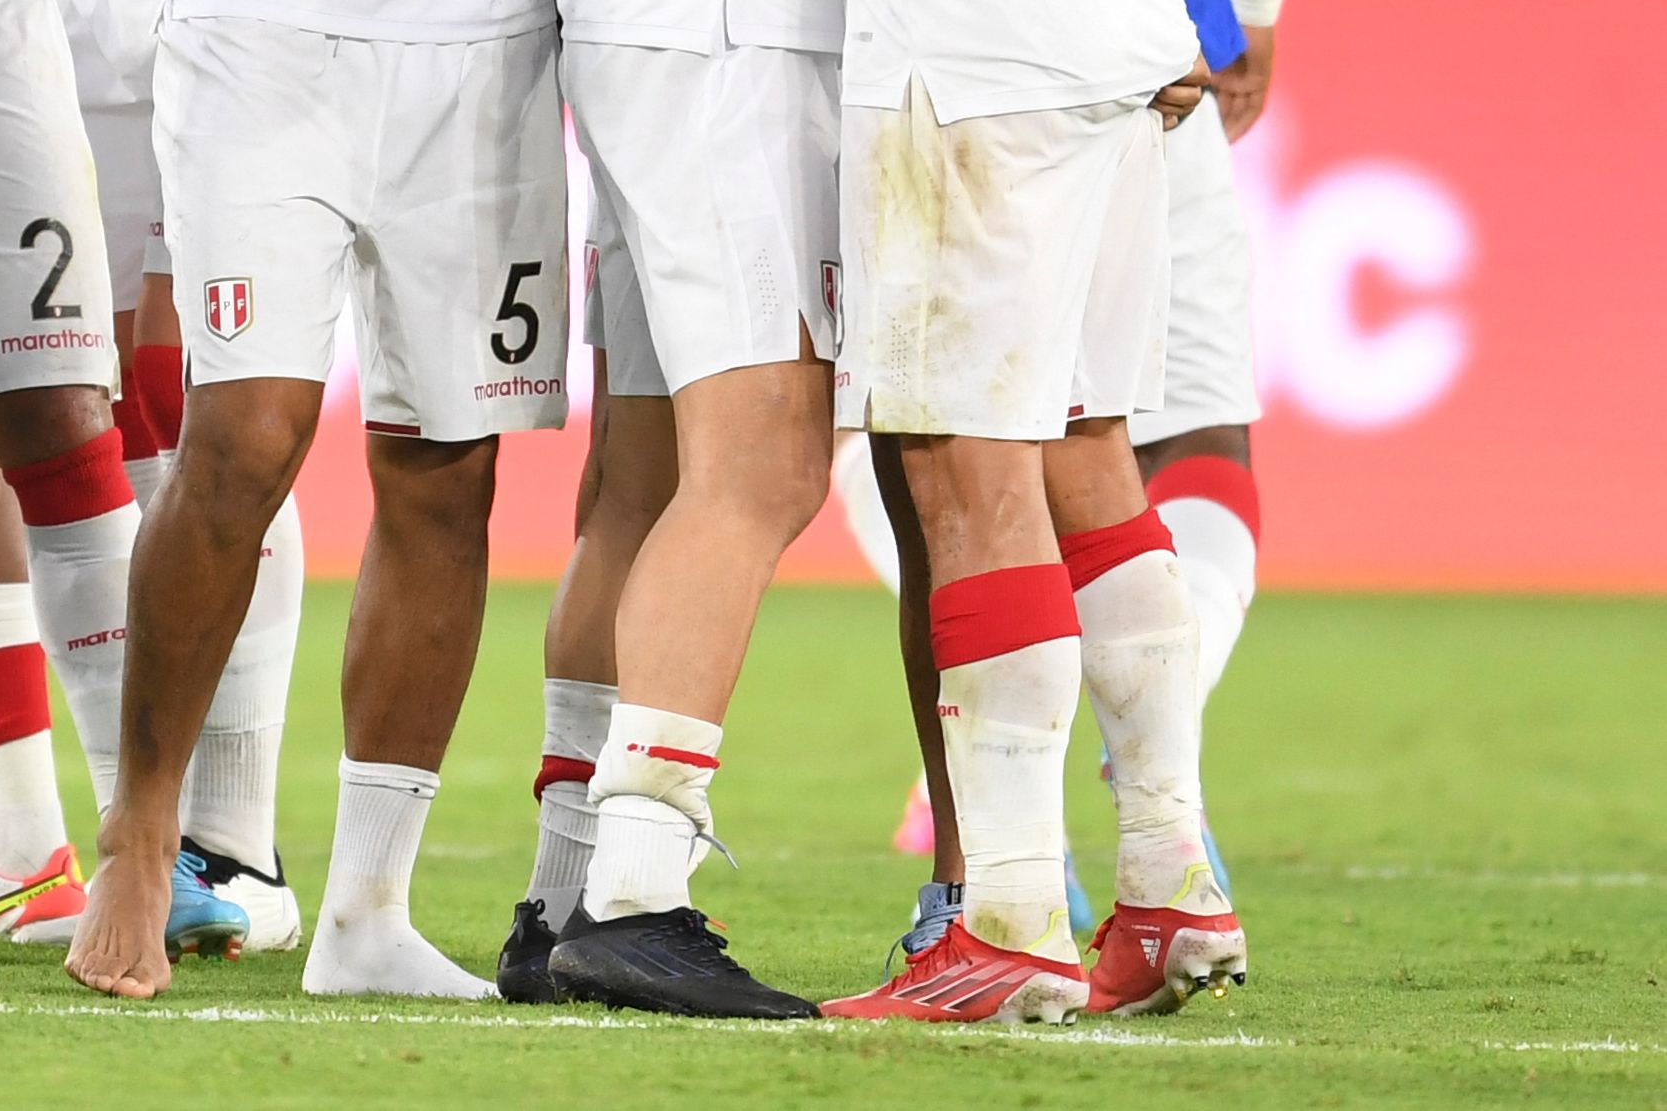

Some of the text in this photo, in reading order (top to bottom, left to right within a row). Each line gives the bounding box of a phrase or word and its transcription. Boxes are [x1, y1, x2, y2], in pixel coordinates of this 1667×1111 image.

[20, 217, 83, 321] 2
[1, 330, 105, 354] marathon
[490, 260, 543, 365] 5
[473, 376, 561, 401] marathon
